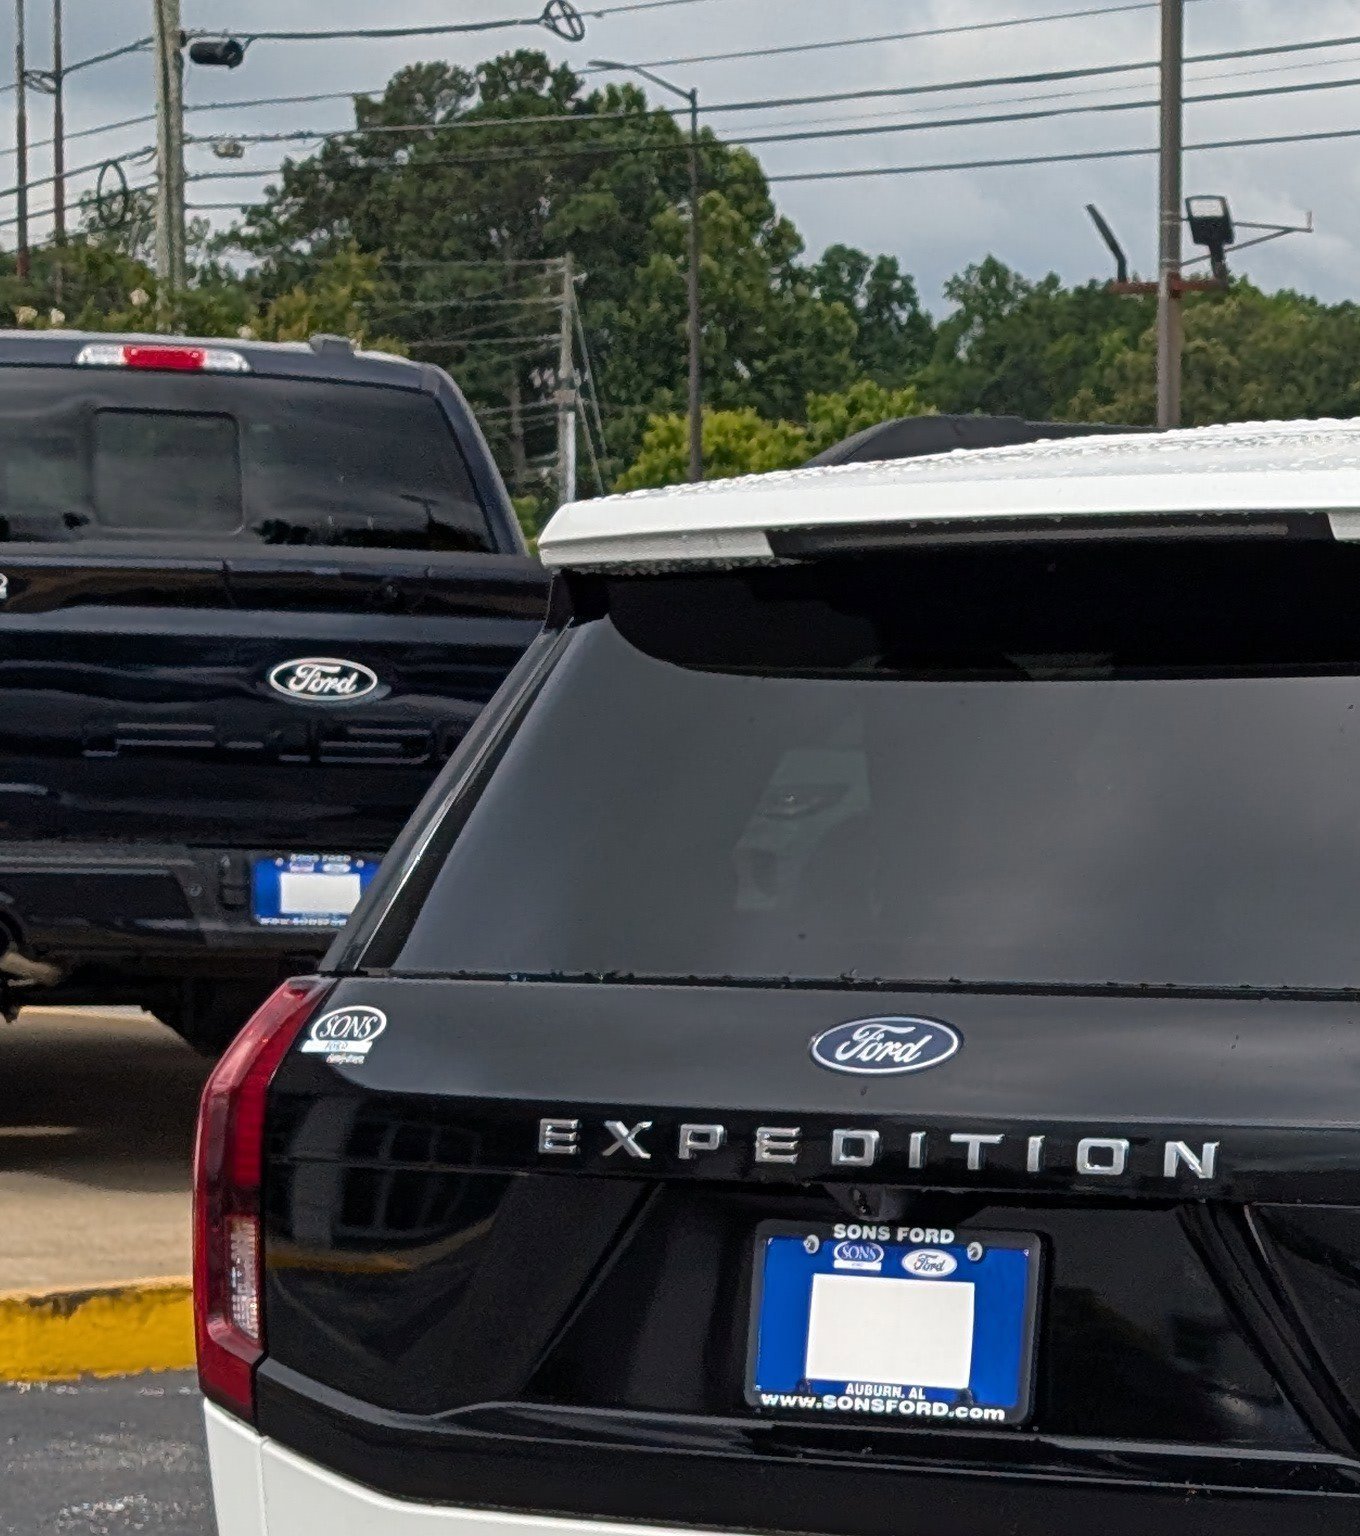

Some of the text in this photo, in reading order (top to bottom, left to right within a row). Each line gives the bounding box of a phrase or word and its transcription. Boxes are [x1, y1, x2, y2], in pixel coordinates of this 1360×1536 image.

[288, 663, 359, 694] Ford
[319, 1014, 379, 1038] SONS
[834, 1023, 933, 1063] Ford
[537, 1117, 1221, 1179] EXPEDITION
[832, 1222, 956, 1244] SONS FORD
[842, 1245, 876, 1261] SONS
[913, 1253, 946, 1272] Ford
[908, 1387, 926, 1400] AL
[760, 1392, 1006, 1421] www.SONSFORD.com
